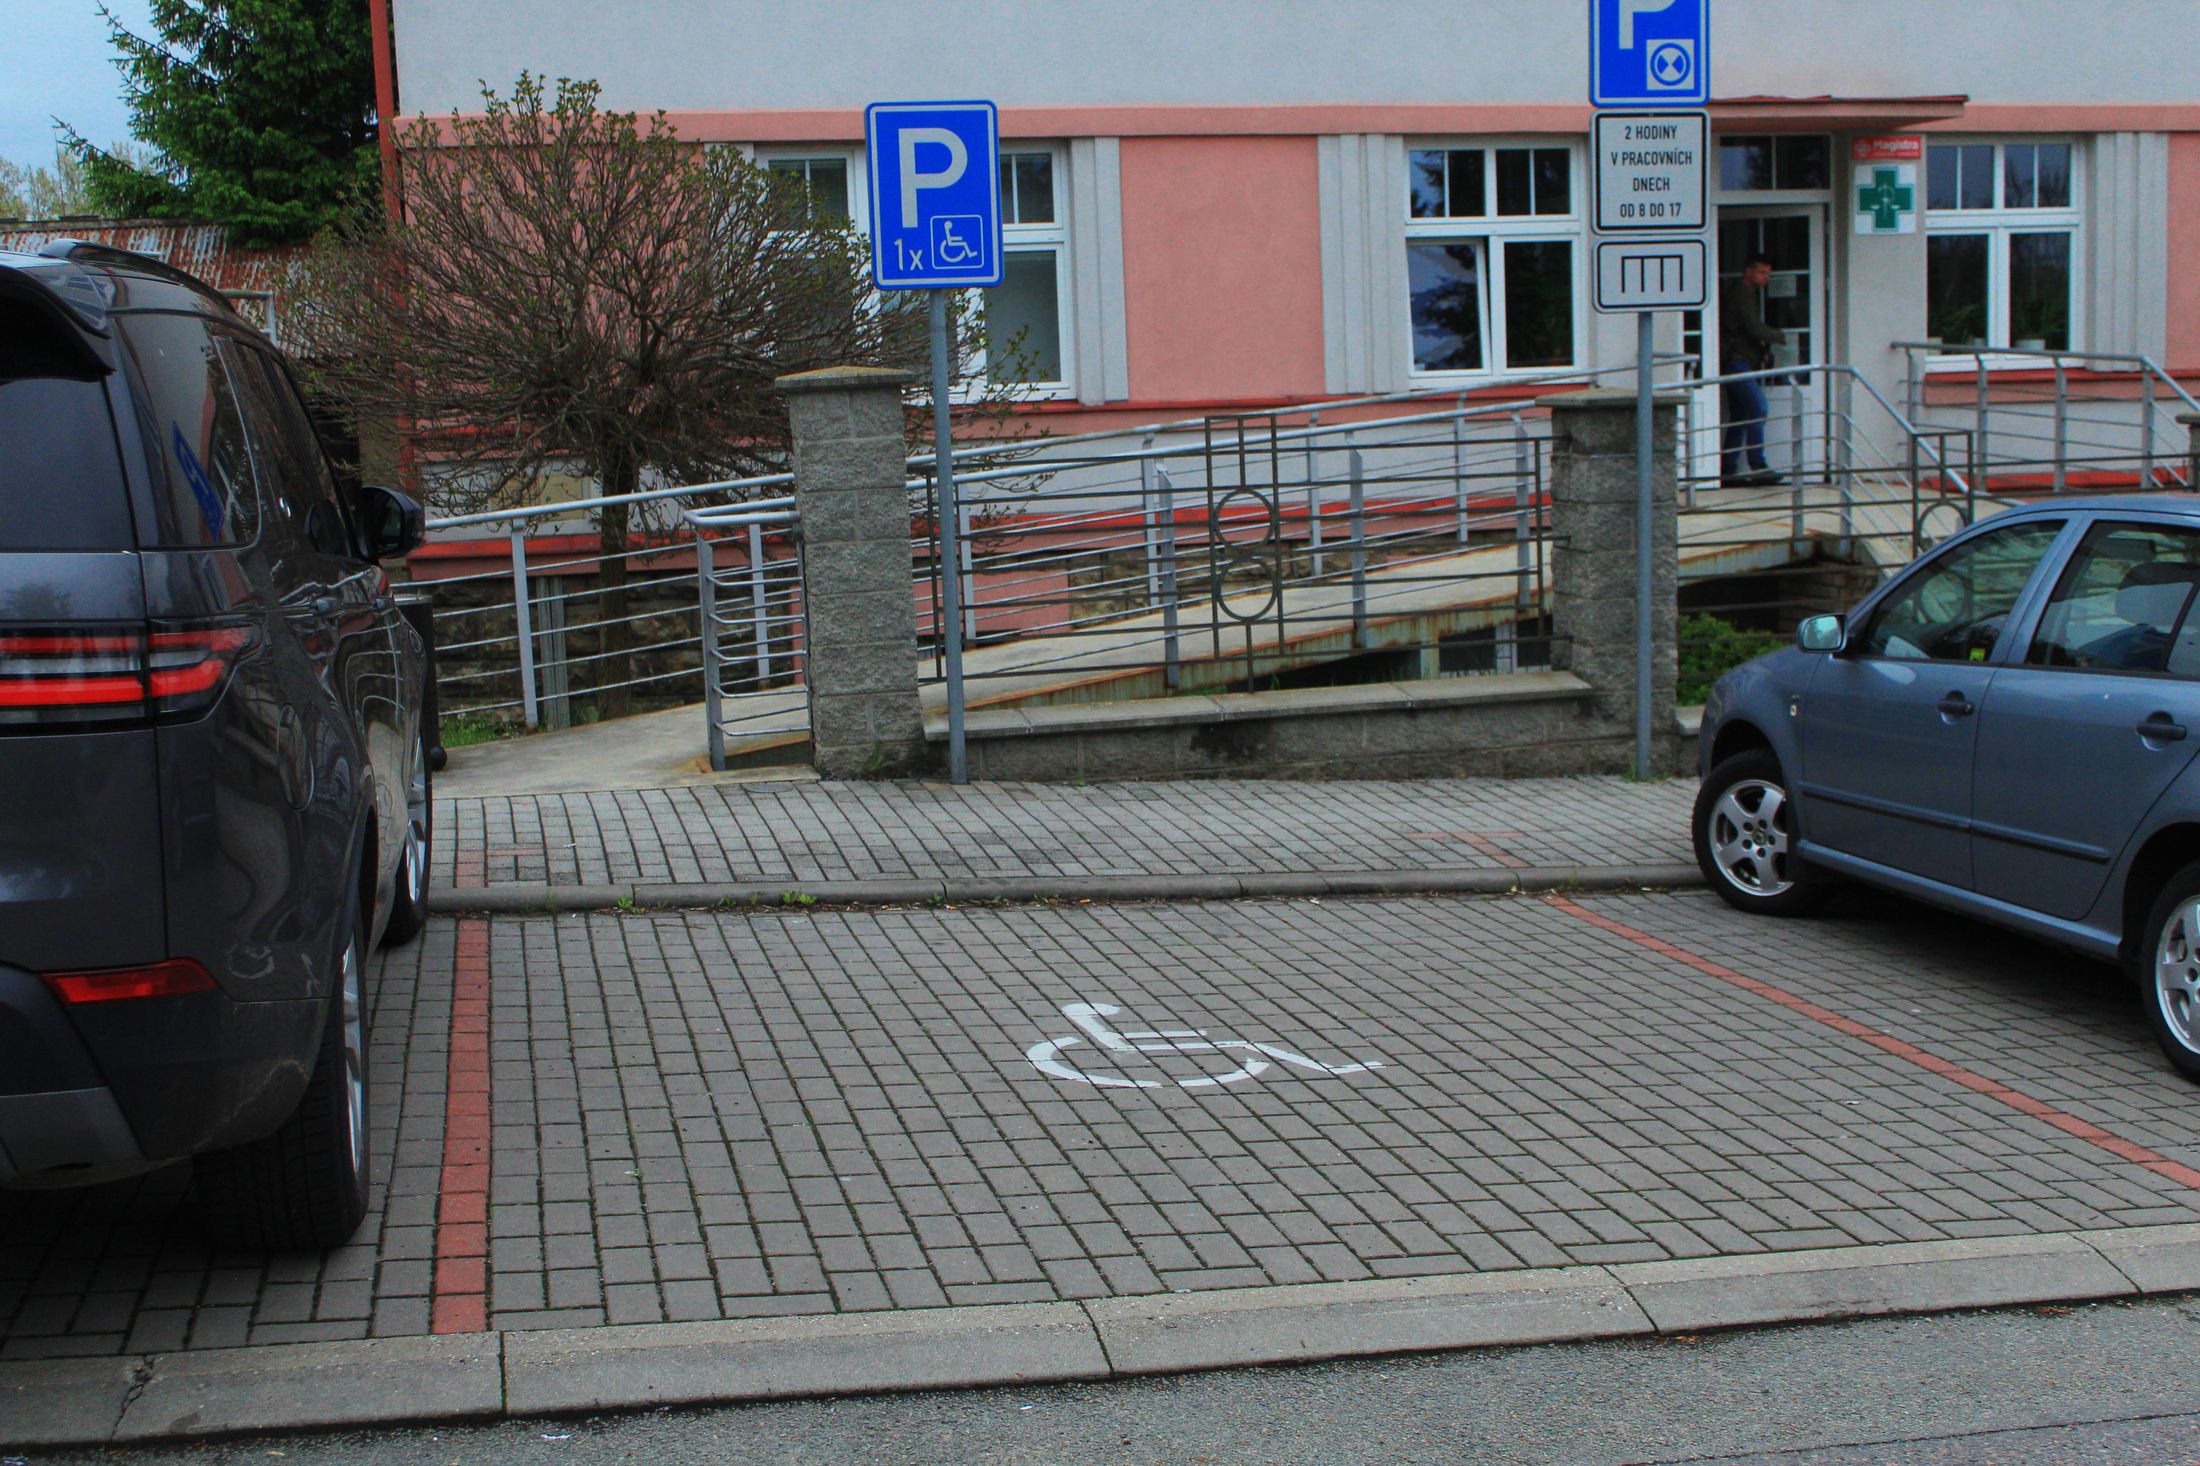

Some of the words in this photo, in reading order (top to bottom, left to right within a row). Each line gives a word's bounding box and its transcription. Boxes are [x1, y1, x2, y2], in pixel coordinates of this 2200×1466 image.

[1625, 126, 1632, 140] 2
[1636, 125, 1677, 140] HODINY
[1611, 152, 1618, 166] V
[1622, 148, 1692, 166] PRACOVNÍCH
[898, 127, 968, 229] P
[1633, 177, 1670, 191] DNECH
[1620, 203, 1635, 217] OD
[1639, 203, 1645, 217] 8
[1650, 202, 1664, 217] DO
[1669, 202, 1681, 217] 17
[894, 238, 924, 271] 1x
